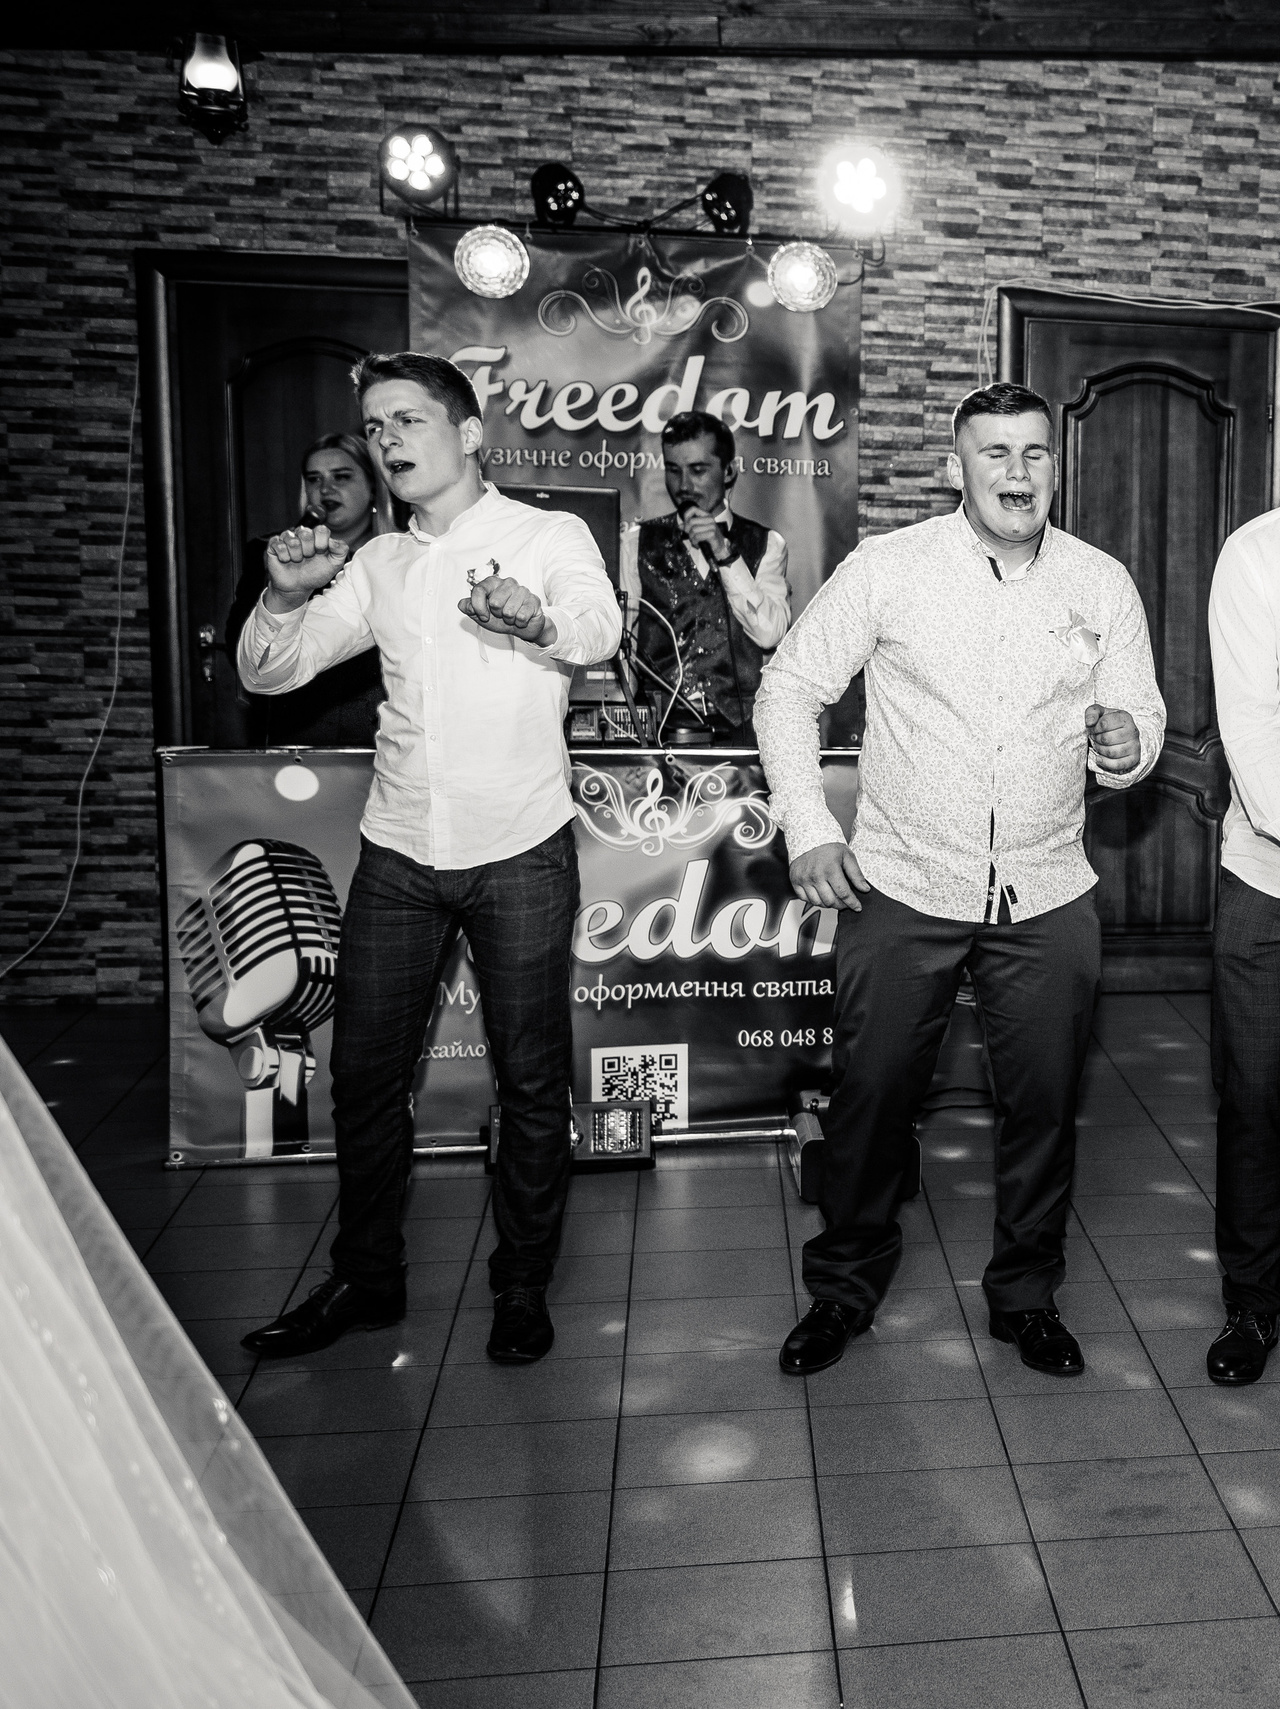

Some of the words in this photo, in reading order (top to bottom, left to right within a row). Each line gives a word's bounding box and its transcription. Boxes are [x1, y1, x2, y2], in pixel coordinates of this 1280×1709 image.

[449, 345, 845, 440] Freedom
[479, 447, 571, 468] узичне
[753, 456, 831, 477] свята
[574, 974, 745, 1010] оформлення
[753, 978, 834, 998] свята
[424, 1040, 486, 1059] хайло
[738, 1029, 774, 1047] 068
[780, 1028, 816, 1047] 048
[823, 1027, 833, 1045] 8
